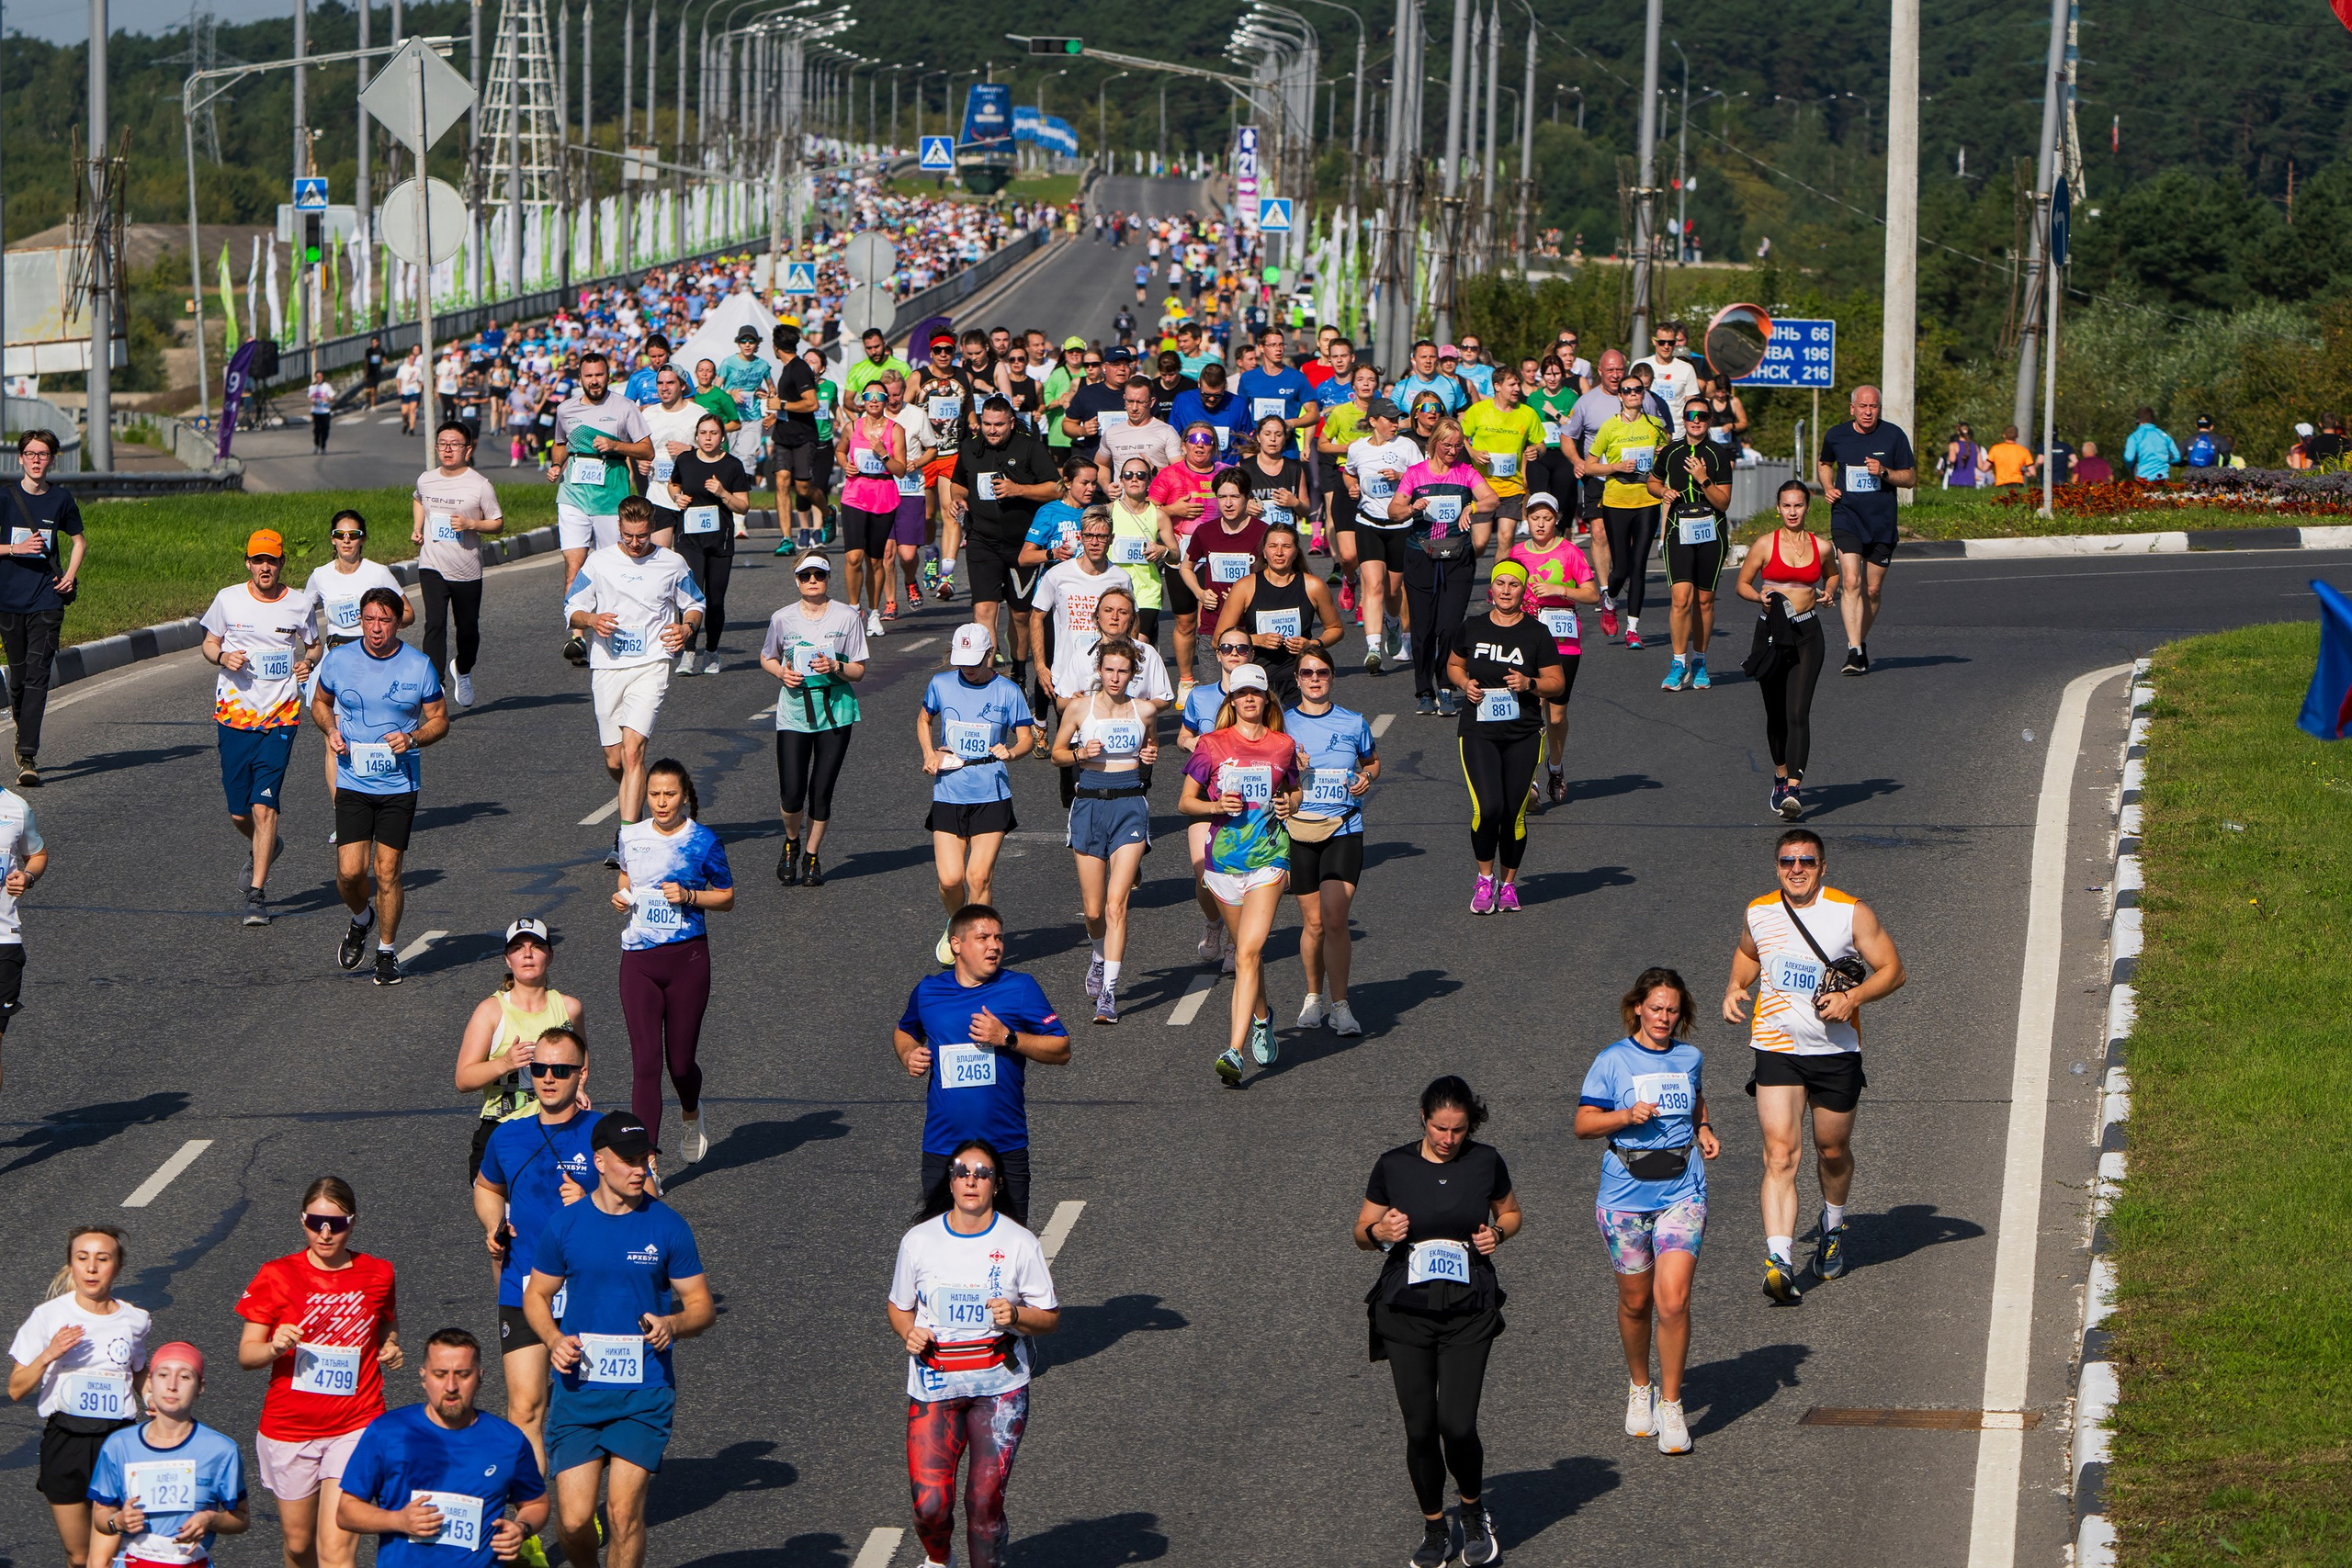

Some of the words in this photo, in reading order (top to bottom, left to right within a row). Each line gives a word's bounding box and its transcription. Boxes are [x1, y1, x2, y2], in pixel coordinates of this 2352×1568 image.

[1811, 326, 1830, 342] 66
[1802, 346, 1830, 361] 196
[1802, 366, 1830, 380] 216
[227, 371, 241, 395] 9
[939, 407, 958, 417] 3175
[1485, 426, 1519, 435] AstraZeneca
[865, 461, 884, 471] 4147
[1498, 464, 1515, 474] 1847
[582, 470, 602, 481] 2484
[899, 479, 917, 490] 1109
[1372, 484, 1393, 495] 4184
[1856, 479, 1879, 489] 4792
[425, 496, 465, 505] TENET
[1270, 512, 1290, 523] 1795
[1439, 509, 1455, 520] 253
[700, 519, 712, 529] 46
[1057, 521, 1077, 533] 2024
[438, 526, 461, 540] 5256
[1694, 528, 1711, 541] 510
[1224, 567, 1246, 579] 1897
[338, 603, 356, 613] РУМИЯ
[337, 609, 362, 625] 1756
[1272, 616, 1296, 625] АНАСТАСИЯ
[1274, 625, 1295, 637] 229
[1555, 622, 1573, 634] 578
[617, 639, 642, 652] 2062
[262, 653, 288, 662] АЛЕКСАНДР
[1474, 642, 1524, 666] FILA
[264, 662, 288, 676] 1405
[1492, 704, 1511, 716] 881
[959, 738, 986, 753] 1493
[1107, 734, 1136, 749] 3234
[370, 751, 385, 760] ИГОРЬ
[366, 760, 392, 773] 1458
[1315, 785, 1343, 799] 3746
[647, 908, 676, 924] 4802
[1783, 962, 1816, 974] АЛЕКСАНДР
[1781, 971, 1815, 990] 2190
[956, 1054, 989, 1064] ВЛАДИМИР
[956, 1064, 991, 1082] 2463
[1661, 1083, 1679, 1091] МАРИЯ
[1657, 1093, 1689, 1110] 4389
[1430, 1249, 1462, 1261] ЕКАТЕРИНА
[1428, 1258, 1463, 1277] 4021
[950, 1293, 979, 1303] НАТАЛЬЯ
[948, 1304, 984, 1323] 1479
[605, 1347, 630, 1357] НИКИТА
[321, 1358, 350, 1369] ТАТЬЯНА
[599, 1358, 637, 1377] 2473
[313, 1369, 355, 1390] 4799
[87, 1382, 112, 1392] ОКСАНА
[79, 1392, 119, 1413] 3910
[156, 1472, 179, 1483] АЛЁНА
[151, 1485, 189, 1506] 1232
[444, 1506, 468, 1518] ПАВЕЛ
